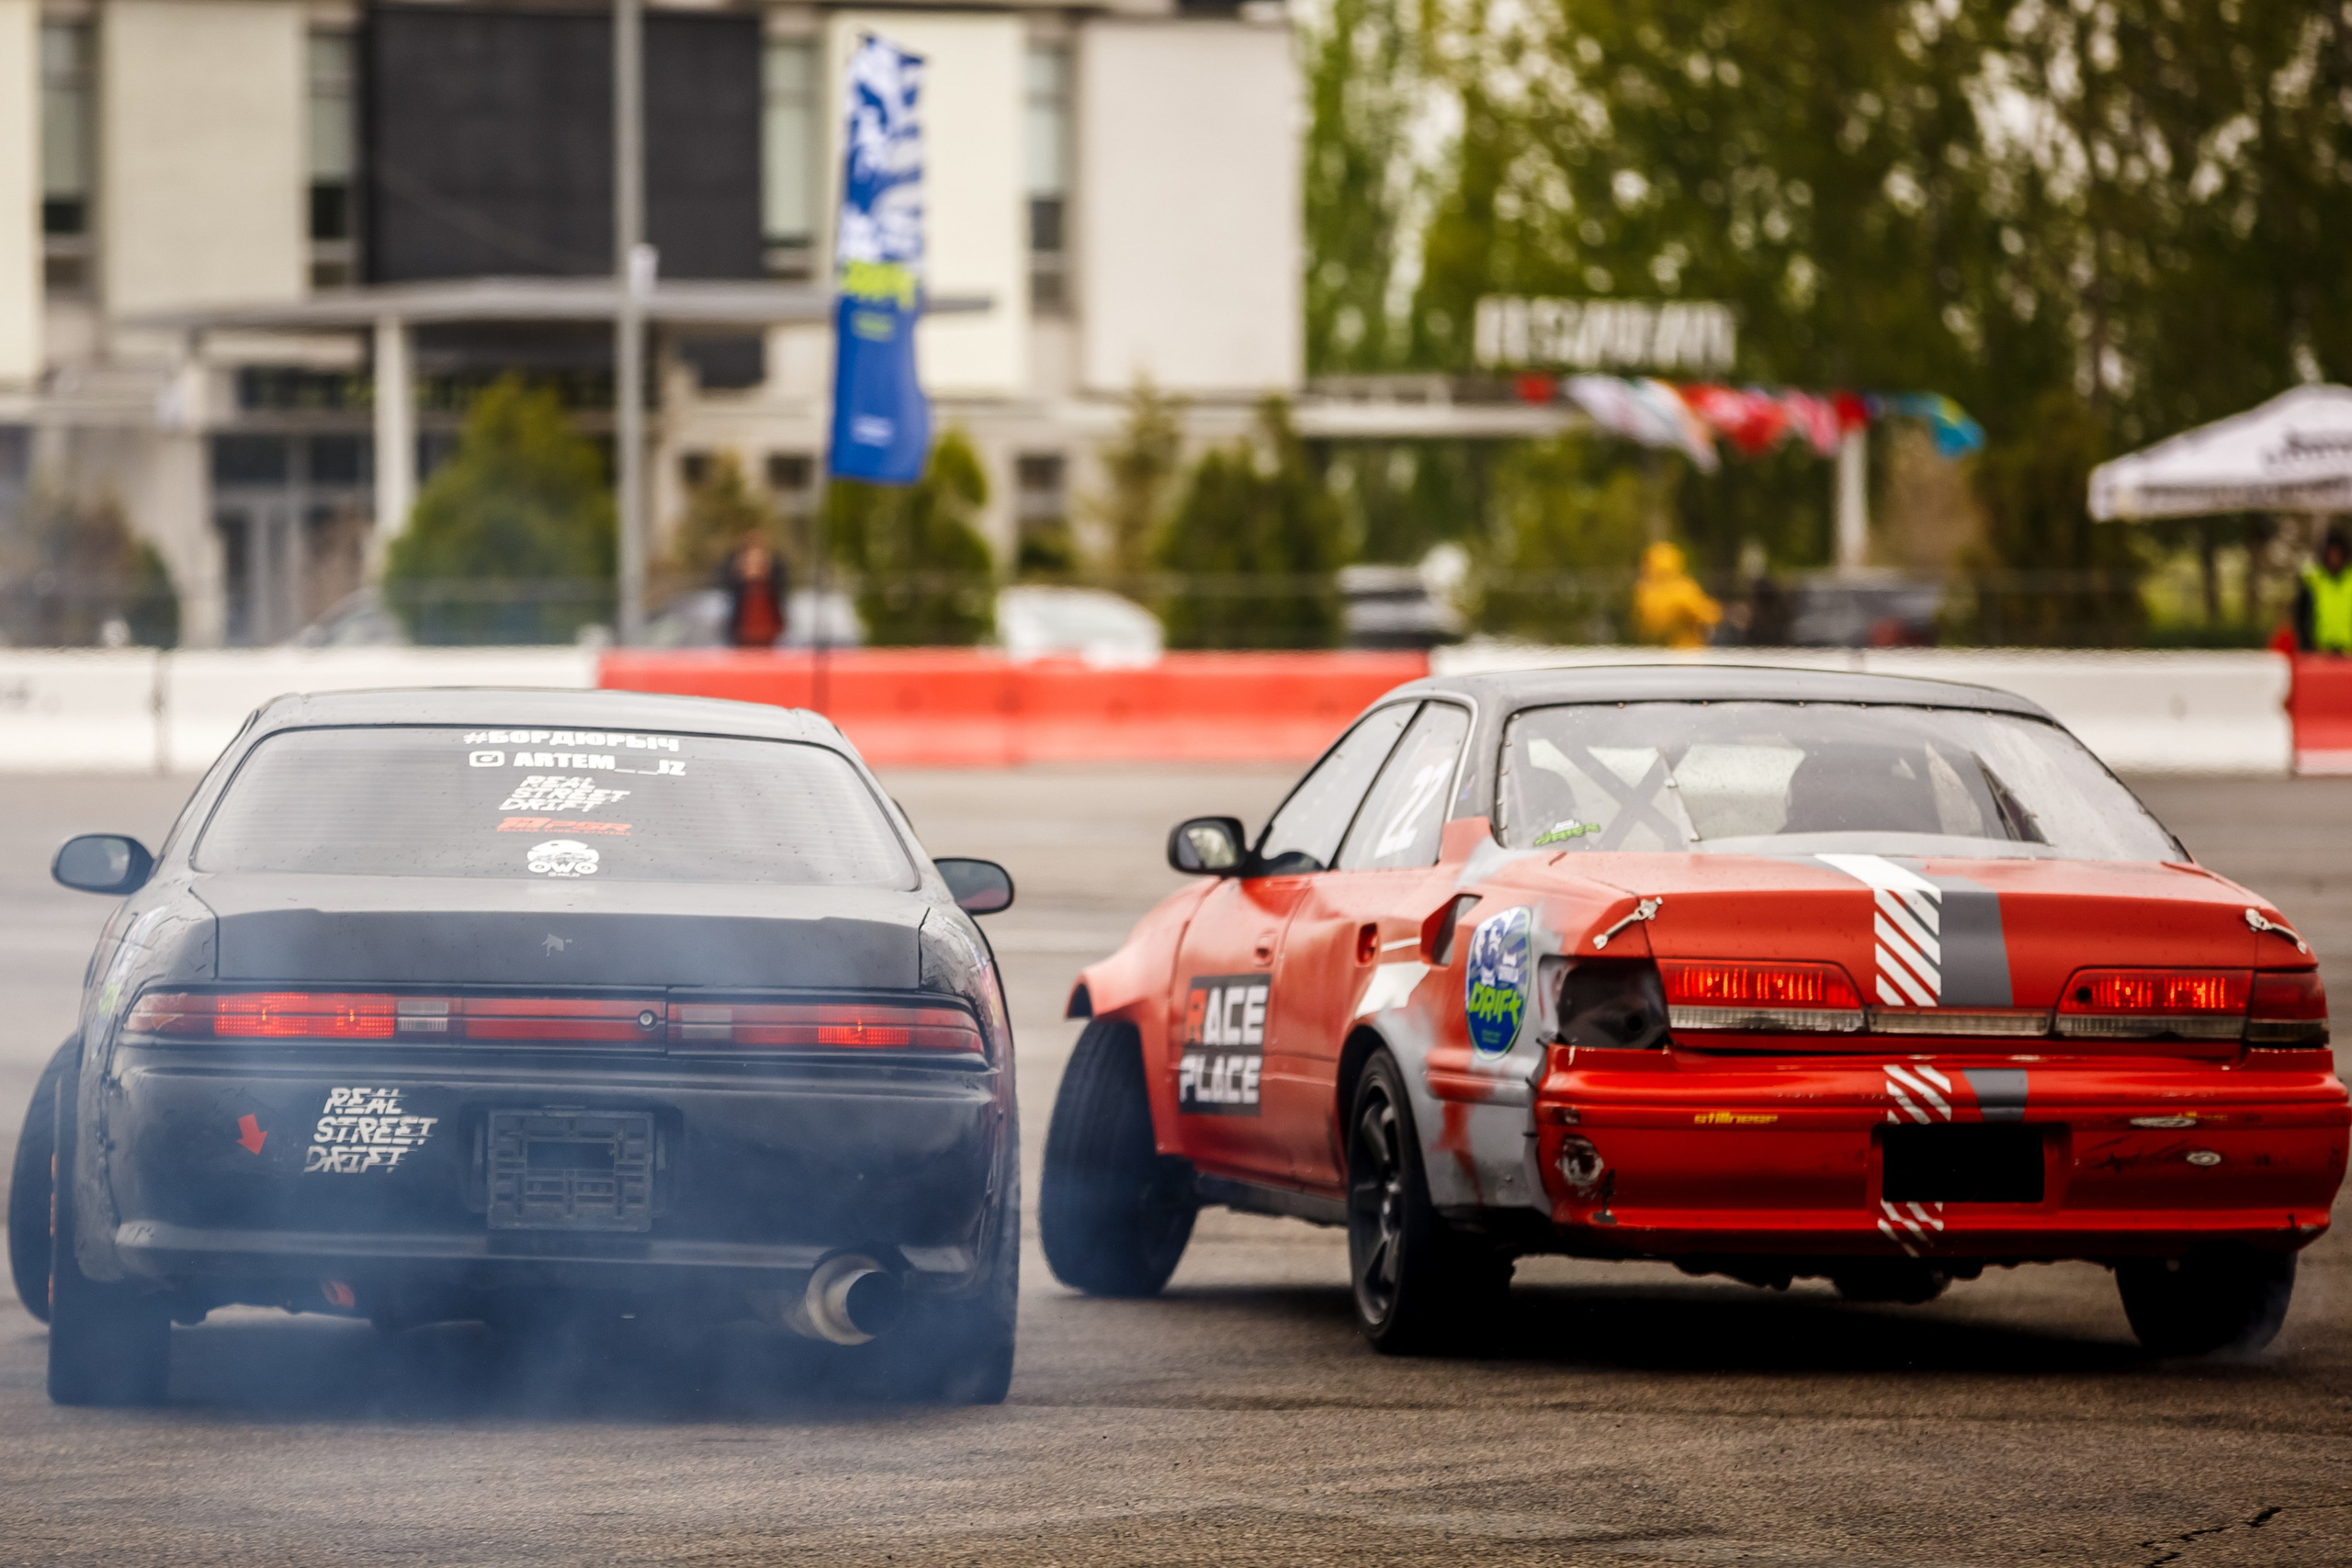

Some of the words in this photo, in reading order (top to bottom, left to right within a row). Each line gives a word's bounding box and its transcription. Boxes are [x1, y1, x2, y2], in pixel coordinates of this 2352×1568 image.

[511, 787, 631, 803] STREET
[519, 775, 596, 790] REAL
[498, 798, 605, 812] DRIFT
[1184, 986, 1269, 1045] RACE
[1180, 1055, 1262, 1104] PLACE
[322, 1087, 404, 1114] REAL
[313, 1116, 439, 1145] STREET
[303, 1145, 413, 1174] DRIFT
